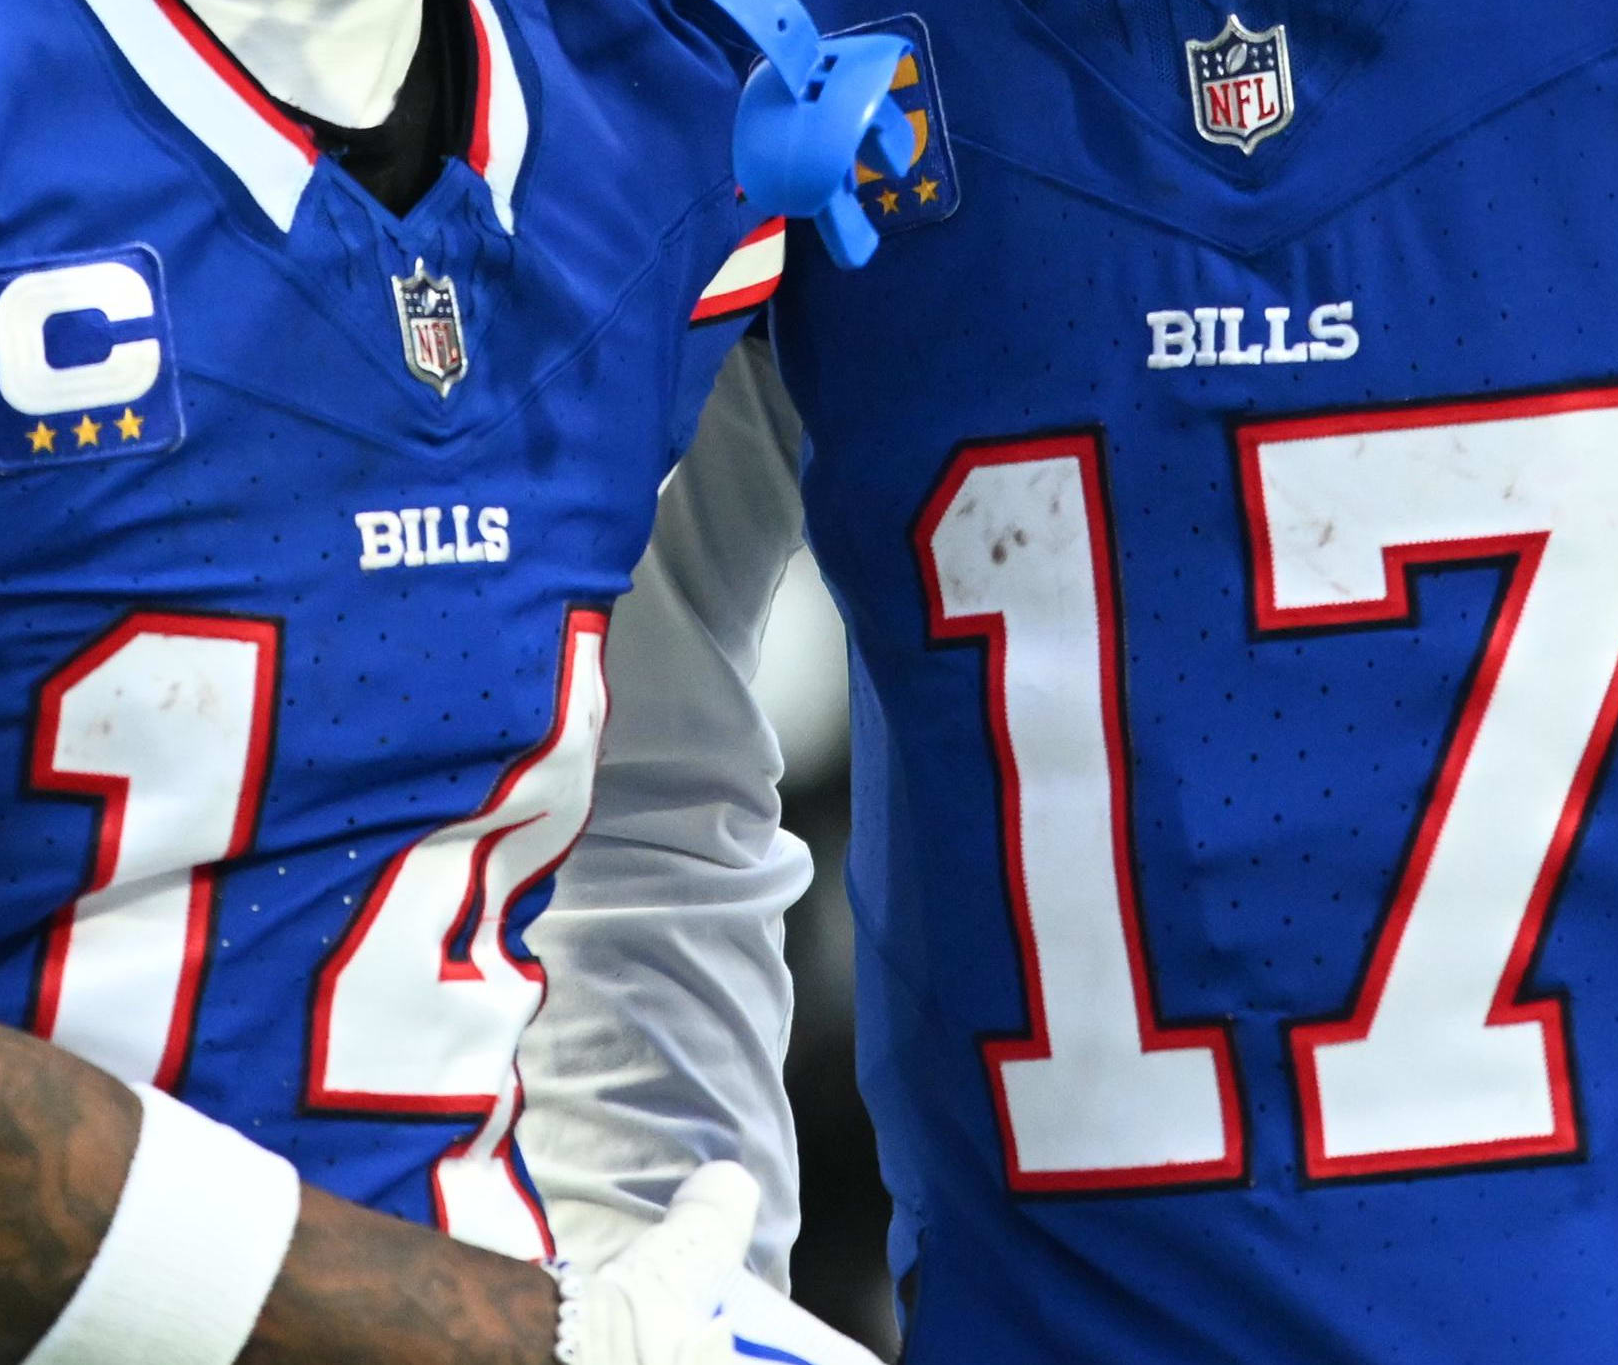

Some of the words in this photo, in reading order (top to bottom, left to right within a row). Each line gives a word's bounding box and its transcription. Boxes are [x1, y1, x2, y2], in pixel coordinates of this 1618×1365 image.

[1206, 77, 1276, 130] NFL
[414, 320, 462, 370] NFL
[1146, 301, 1360, 370] BILLS
[355, 504, 511, 572] BILLS
[23, 609, 610, 1265] 14
